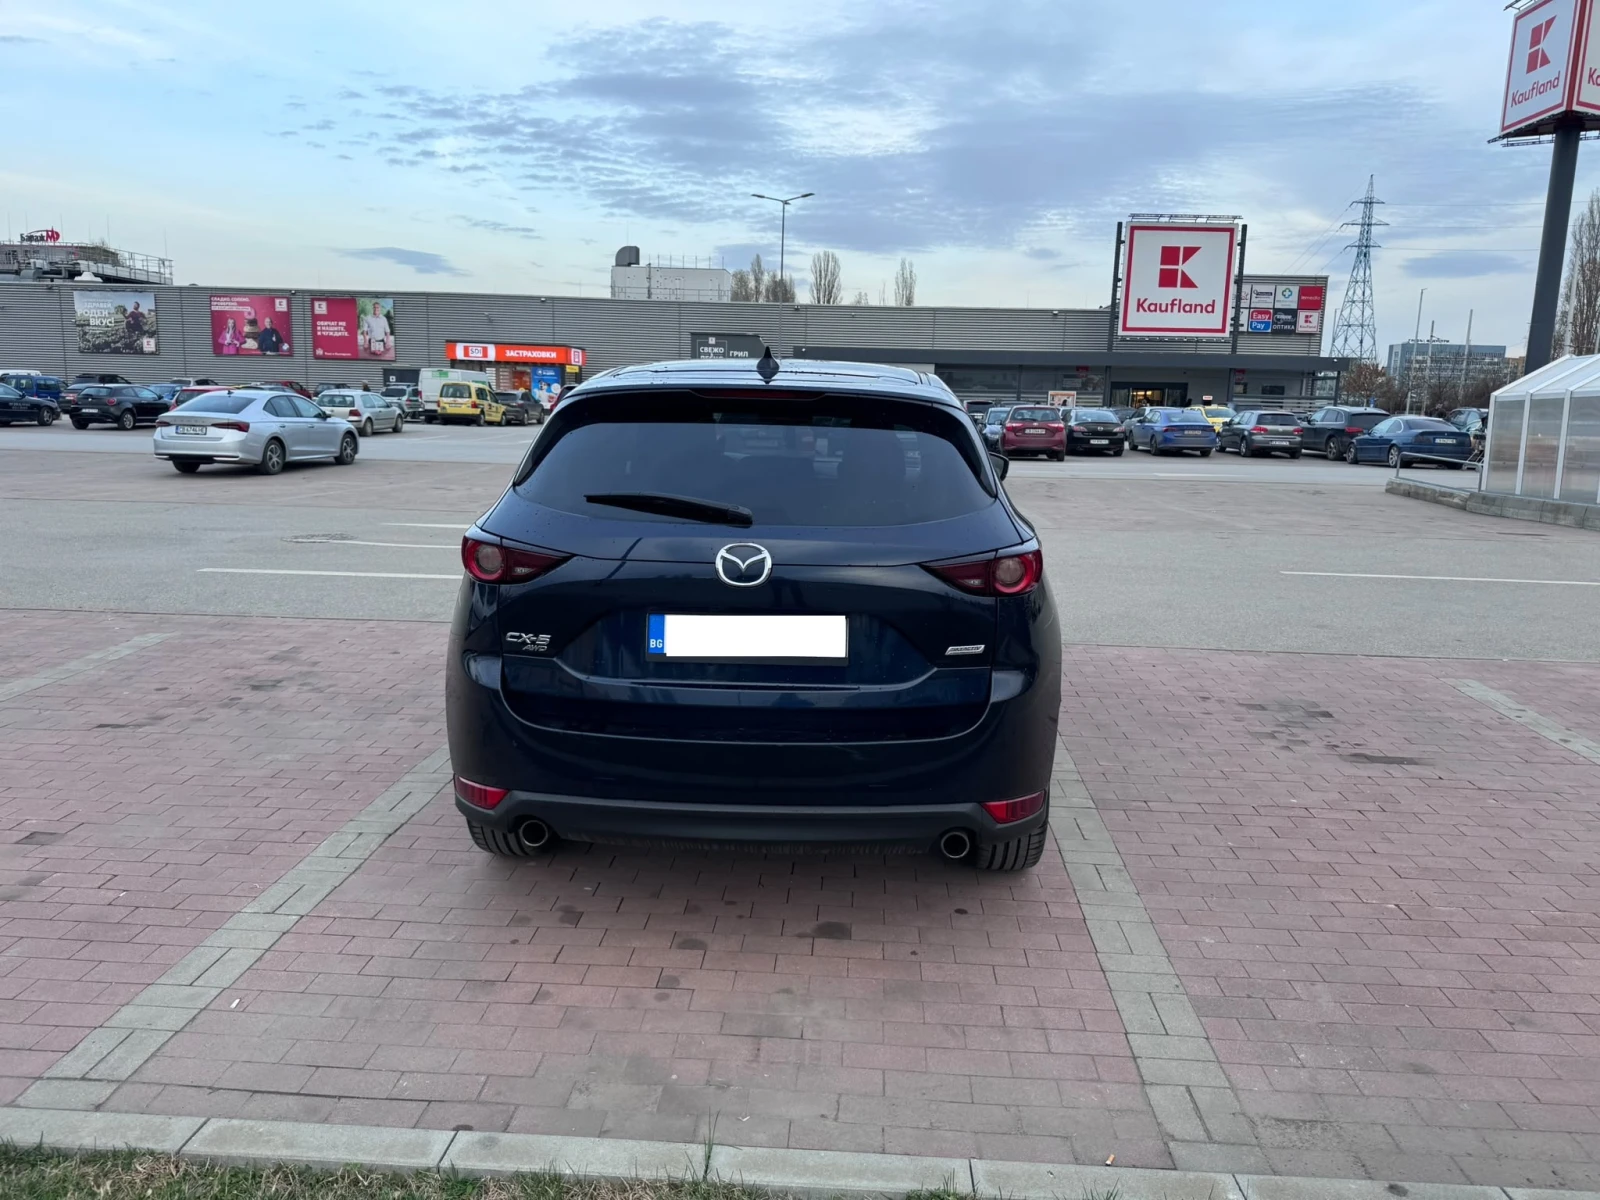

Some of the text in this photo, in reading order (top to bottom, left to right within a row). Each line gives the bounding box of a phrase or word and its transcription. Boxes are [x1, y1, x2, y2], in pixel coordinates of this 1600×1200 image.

[1510, 70, 1561, 108] Kaufland
[1136, 297, 1216, 314] Kaufland
[77, 309, 109, 317] РОДЕН
[1252, 312, 1270, 320] Easy
[90, 317, 115, 326] ВКУС!
[1252, 322, 1266, 330] Pay
[470, 347, 482, 355] SDI
[505, 349, 557, 359] ЗАСТРАХОВКИ
[700, 346, 725, 354] СВЕЖО
[729, 350, 749, 358] ГРИЛ
[506, 631, 552, 645] CX-5
[650, 638, 663, 649] BG
[522, 644, 548, 652] AWD
